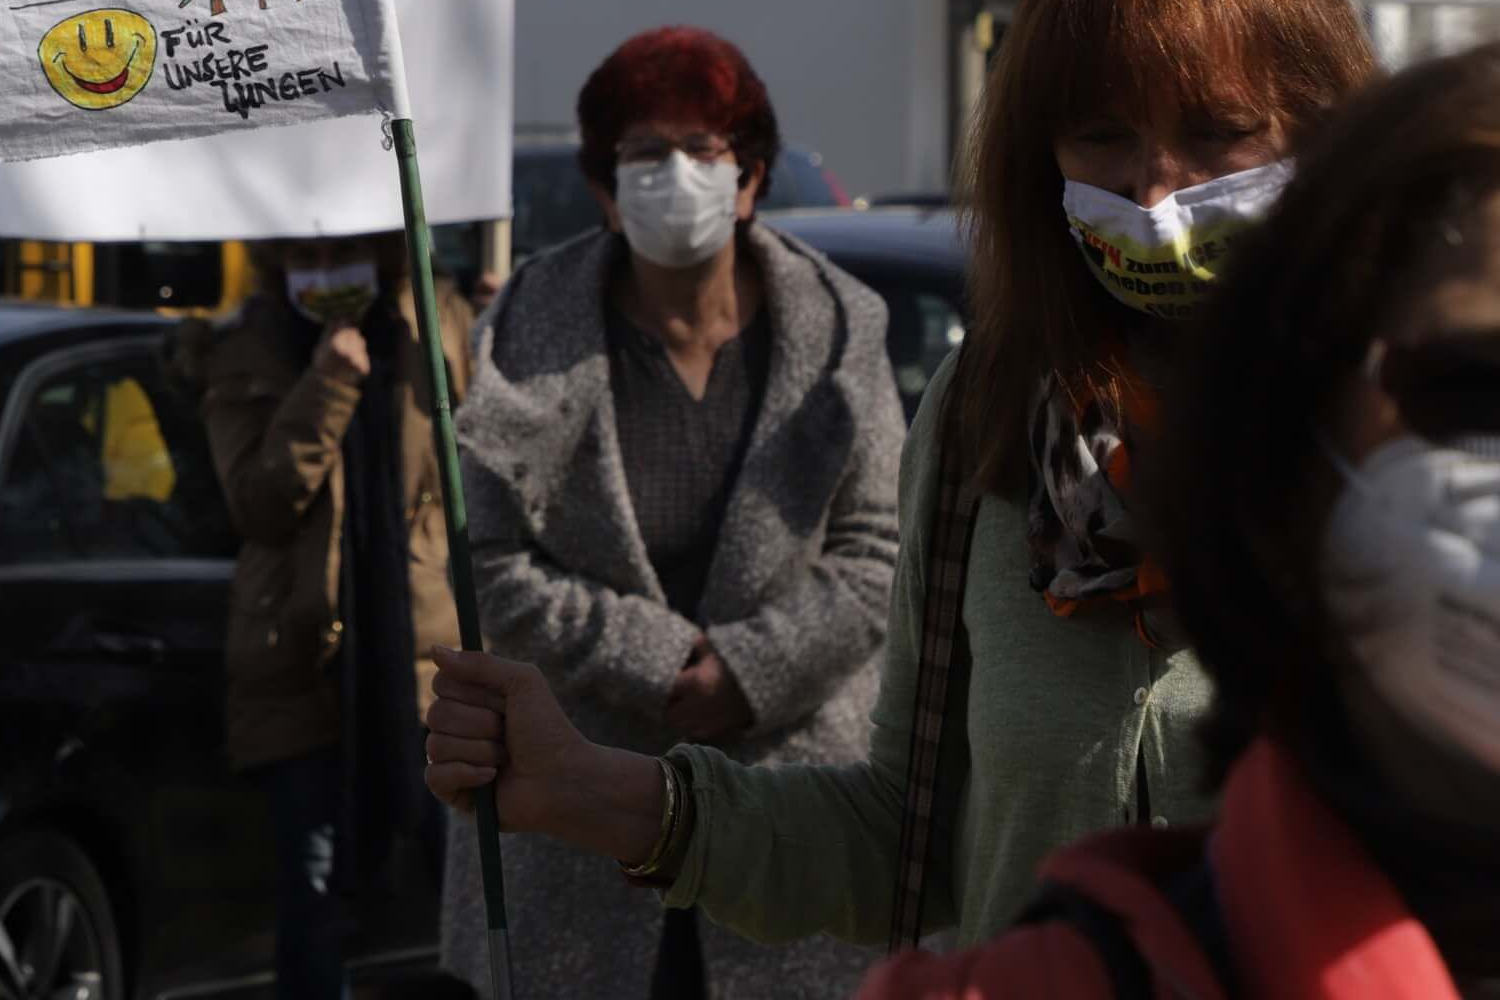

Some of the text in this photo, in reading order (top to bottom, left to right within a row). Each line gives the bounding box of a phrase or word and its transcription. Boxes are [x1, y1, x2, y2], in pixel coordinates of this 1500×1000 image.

[159, 18, 232, 58] FÜR
[162, 43, 270, 91] UNSERE
[209, 60, 347, 120] LUNGEN
[1125, 256, 1180, 275] zum
